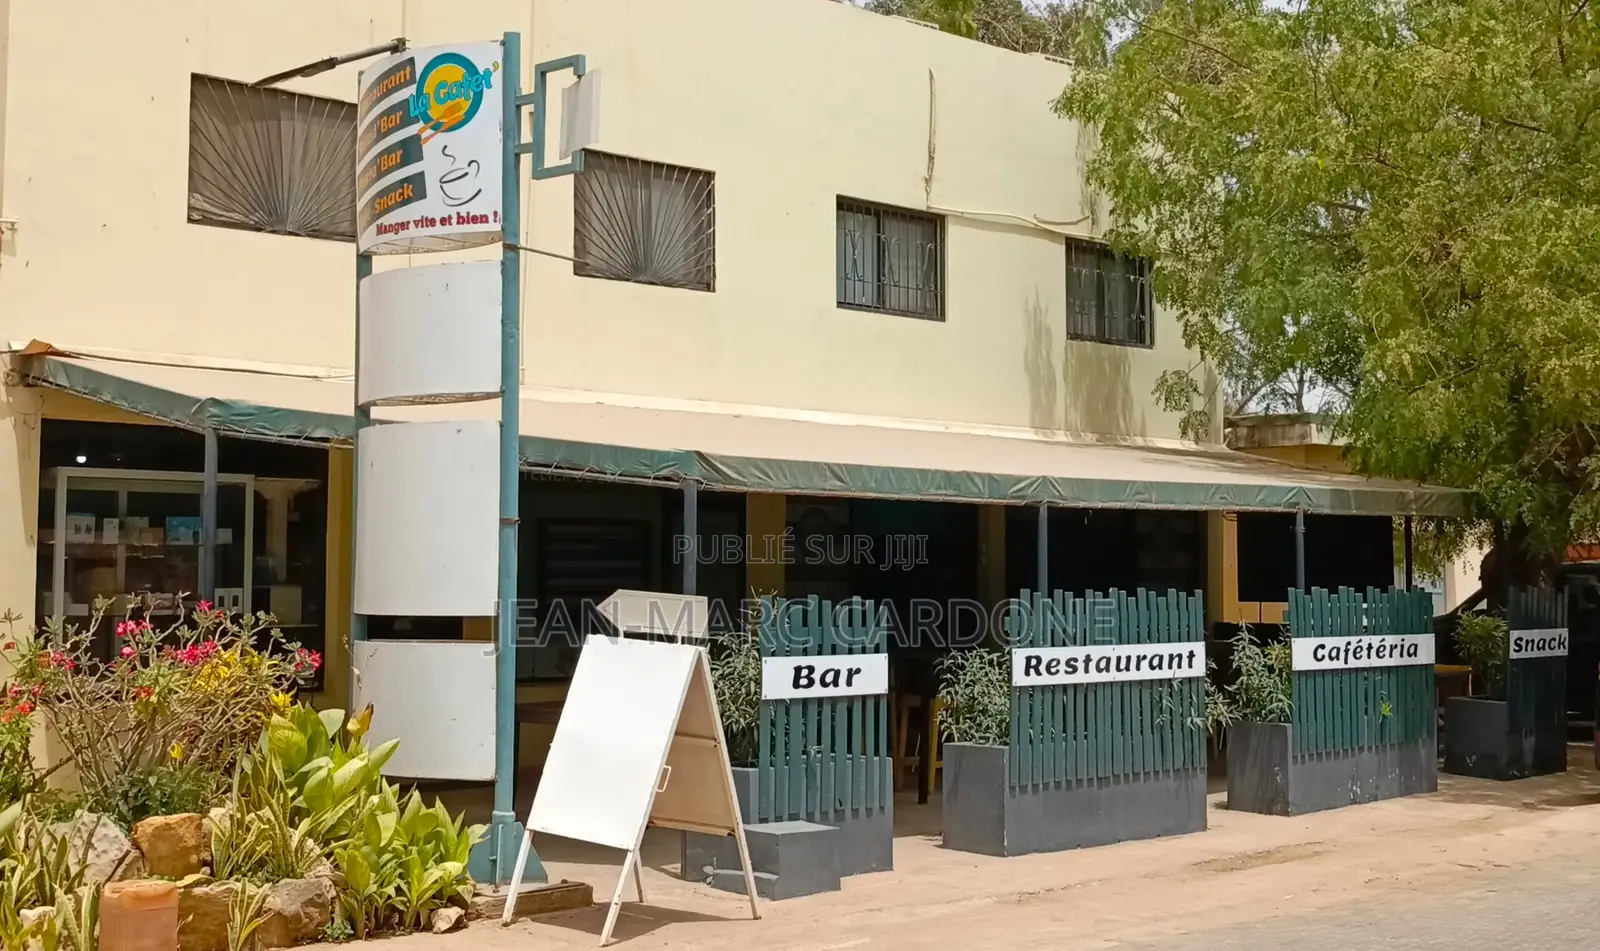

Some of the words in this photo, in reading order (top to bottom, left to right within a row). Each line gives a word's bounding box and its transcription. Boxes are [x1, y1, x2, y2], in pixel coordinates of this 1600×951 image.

[408, 93, 431, 117] La
[376, 221, 411, 236] Manger
[412, 215, 437, 229] vite
[439, 214, 453, 226] et
[456, 211, 490, 225] bien
[1312, 638, 1419, 665] Cafétéria
[1512, 633, 1567, 654] Snack
[1023, 649, 1196, 677] Restaurant
[792, 664, 862, 690] Bar
